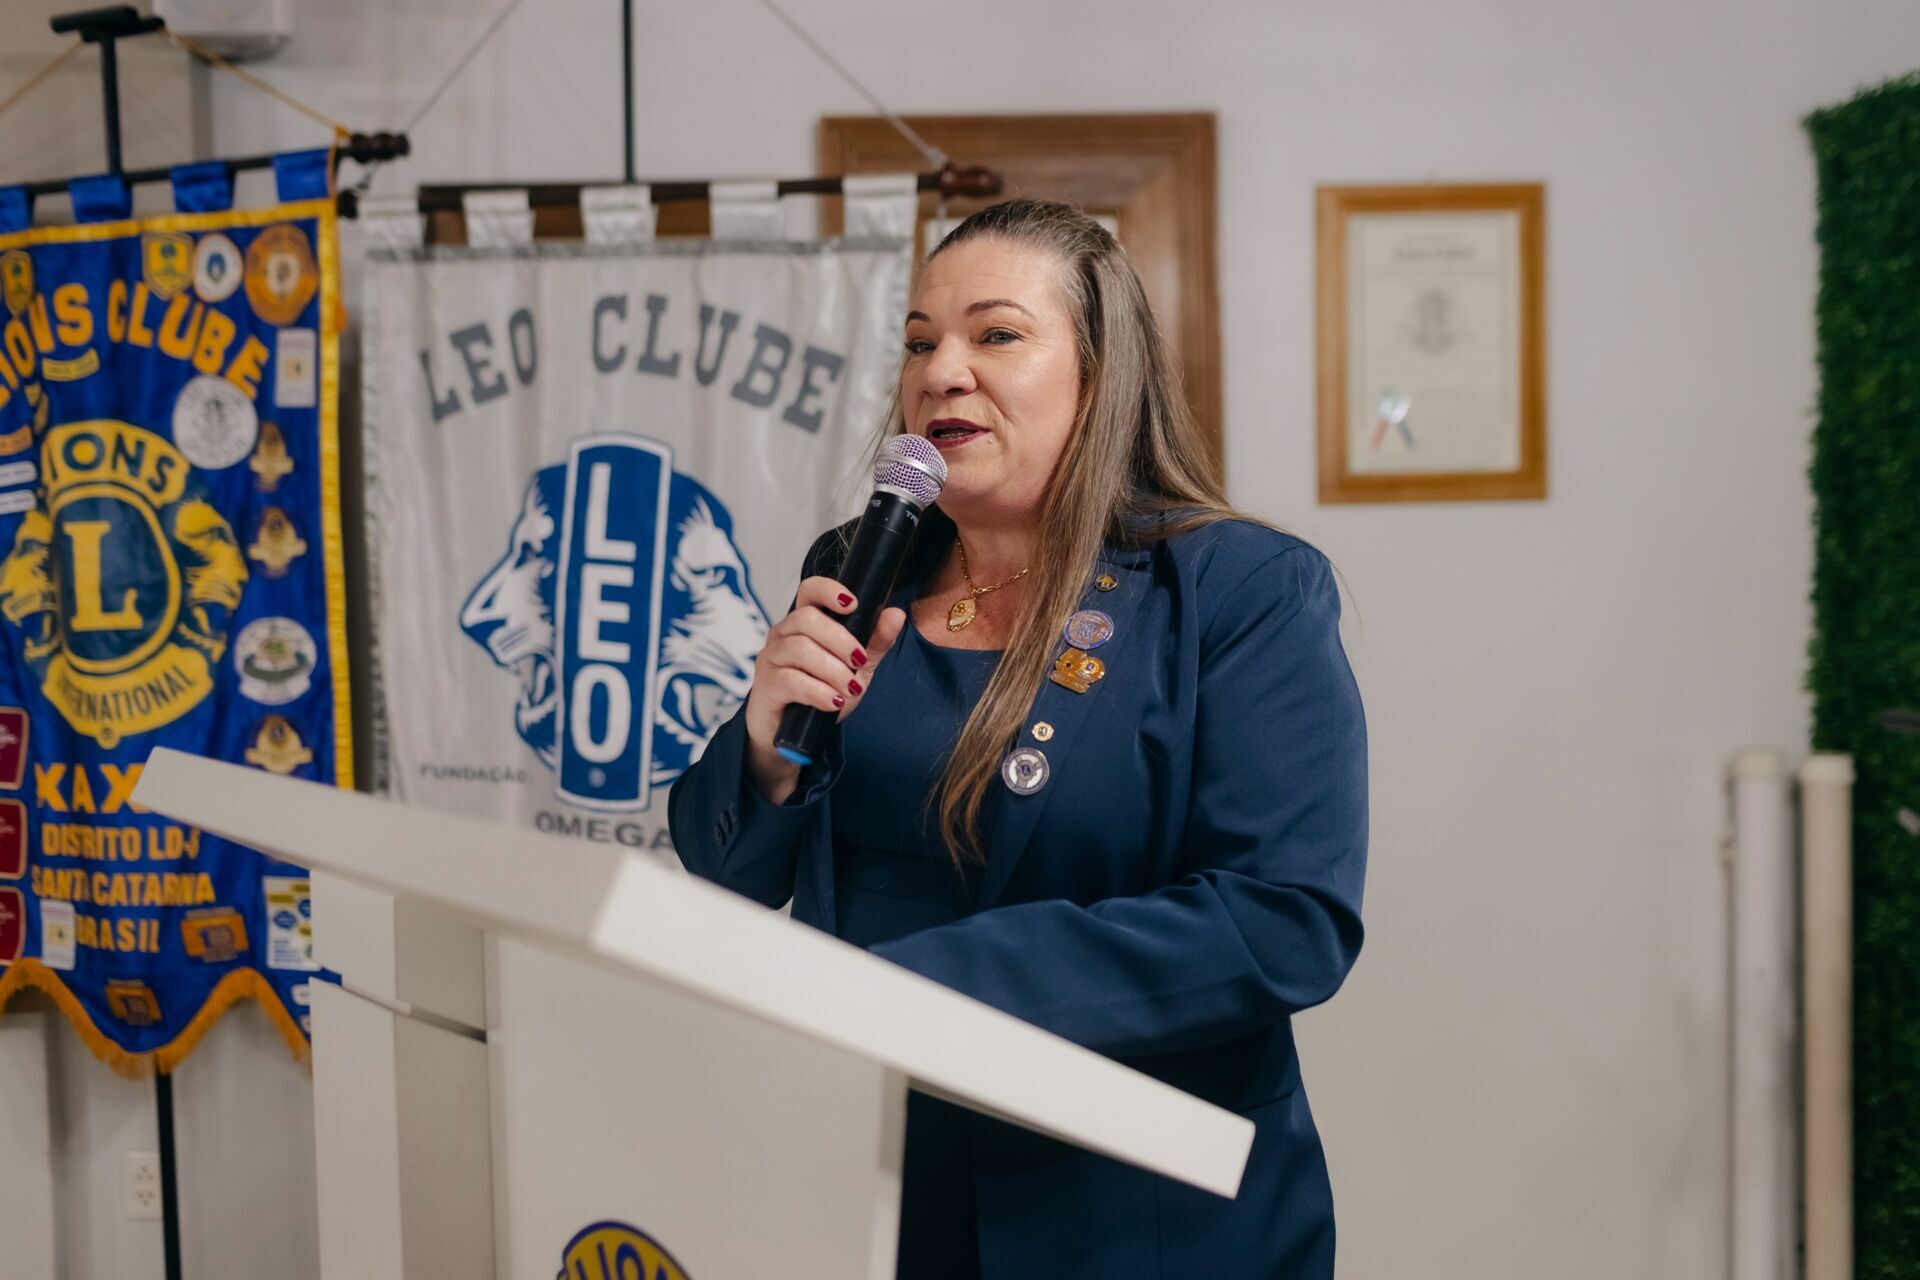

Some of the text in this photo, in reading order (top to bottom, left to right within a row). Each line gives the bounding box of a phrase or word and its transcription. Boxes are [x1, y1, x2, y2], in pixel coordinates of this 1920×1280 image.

[0, 278, 269, 407] IONS CLUBE
[419, 293, 844, 434] LEO CLUBE
[48, 432, 175, 493] IONS
[63, 520, 143, 632] L
[569, 462, 637, 764] LEO
[34, 762, 152, 814] XAX
[41, 823, 142, 861] DISRITO
